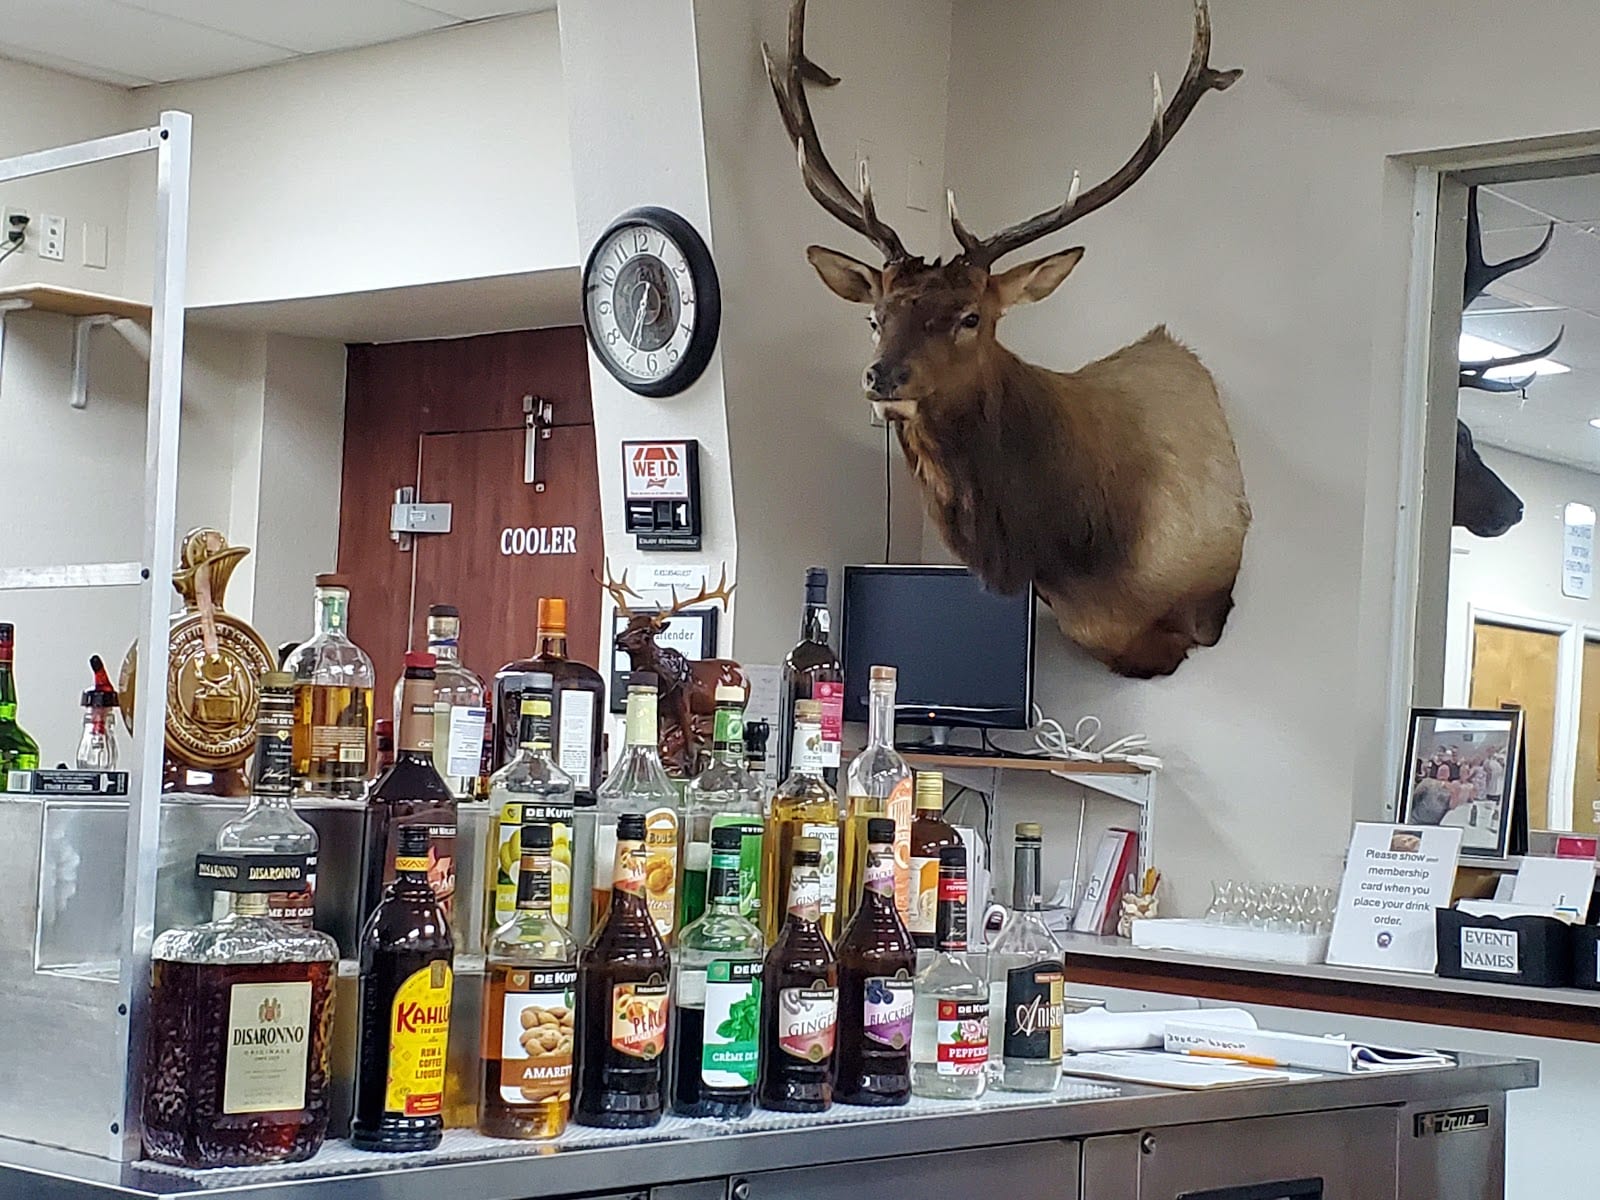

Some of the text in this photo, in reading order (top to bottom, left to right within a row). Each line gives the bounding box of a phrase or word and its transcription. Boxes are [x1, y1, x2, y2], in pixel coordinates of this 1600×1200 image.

[633, 233, 649, 253] 12
[659, 240, 666, 257] 1
[614, 243, 629, 264] 11
[600, 265, 617, 287] 10
[673, 260, 685, 279] 2
[682, 290, 695, 306] 3
[600, 300, 612, 316] 9
[606, 328, 621, 346] 8
[680, 322, 693, 338] 4
[626, 347, 637, 364] 7
[665, 342, 678, 363] 5
[646, 353, 658, 373] 6
[633, 461, 656, 477] WE
[500, 526, 577, 555] COOLER
[525, 808, 544, 817] DE
[1366, 849, 1426, 862] Please show
[249, 866, 301, 881] DISARONNO
[1368, 866, 1430, 880] membership
[1361, 882, 1430, 895] card when you
[1354, 897, 1431, 911] place your drink
[1374, 914, 1402, 926] order.
[1465, 930, 1513, 947] EVENT
[1463, 951, 1514, 969] NAMES
[733, 965, 750, 974] DE
[534, 974, 554, 984] DE
[958, 1005, 972, 1013] DE
[233, 1026, 304, 1046] DISARONNO
